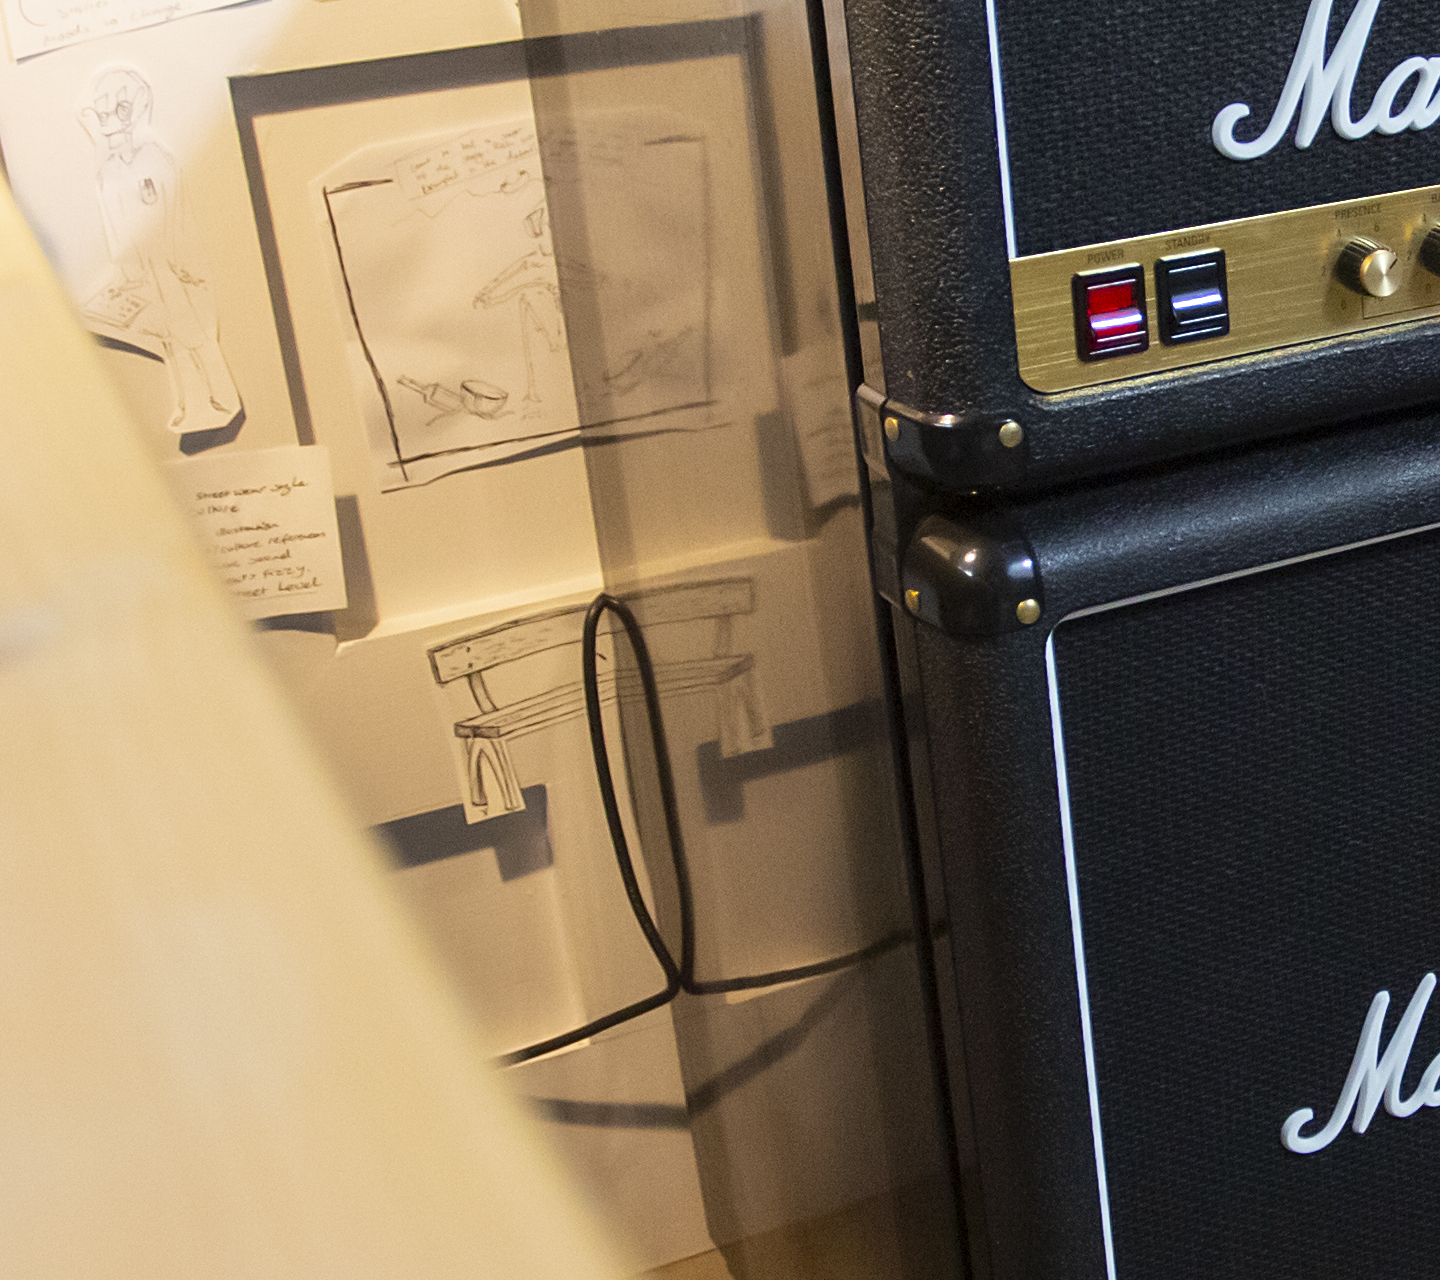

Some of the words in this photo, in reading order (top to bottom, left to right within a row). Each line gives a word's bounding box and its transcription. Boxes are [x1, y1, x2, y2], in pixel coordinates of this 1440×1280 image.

[1334, 202, 1382, 220] PRESENCE
[1163, 234, 1211, 251] STANDBY
[1086, 247, 1125, 265] POWER
